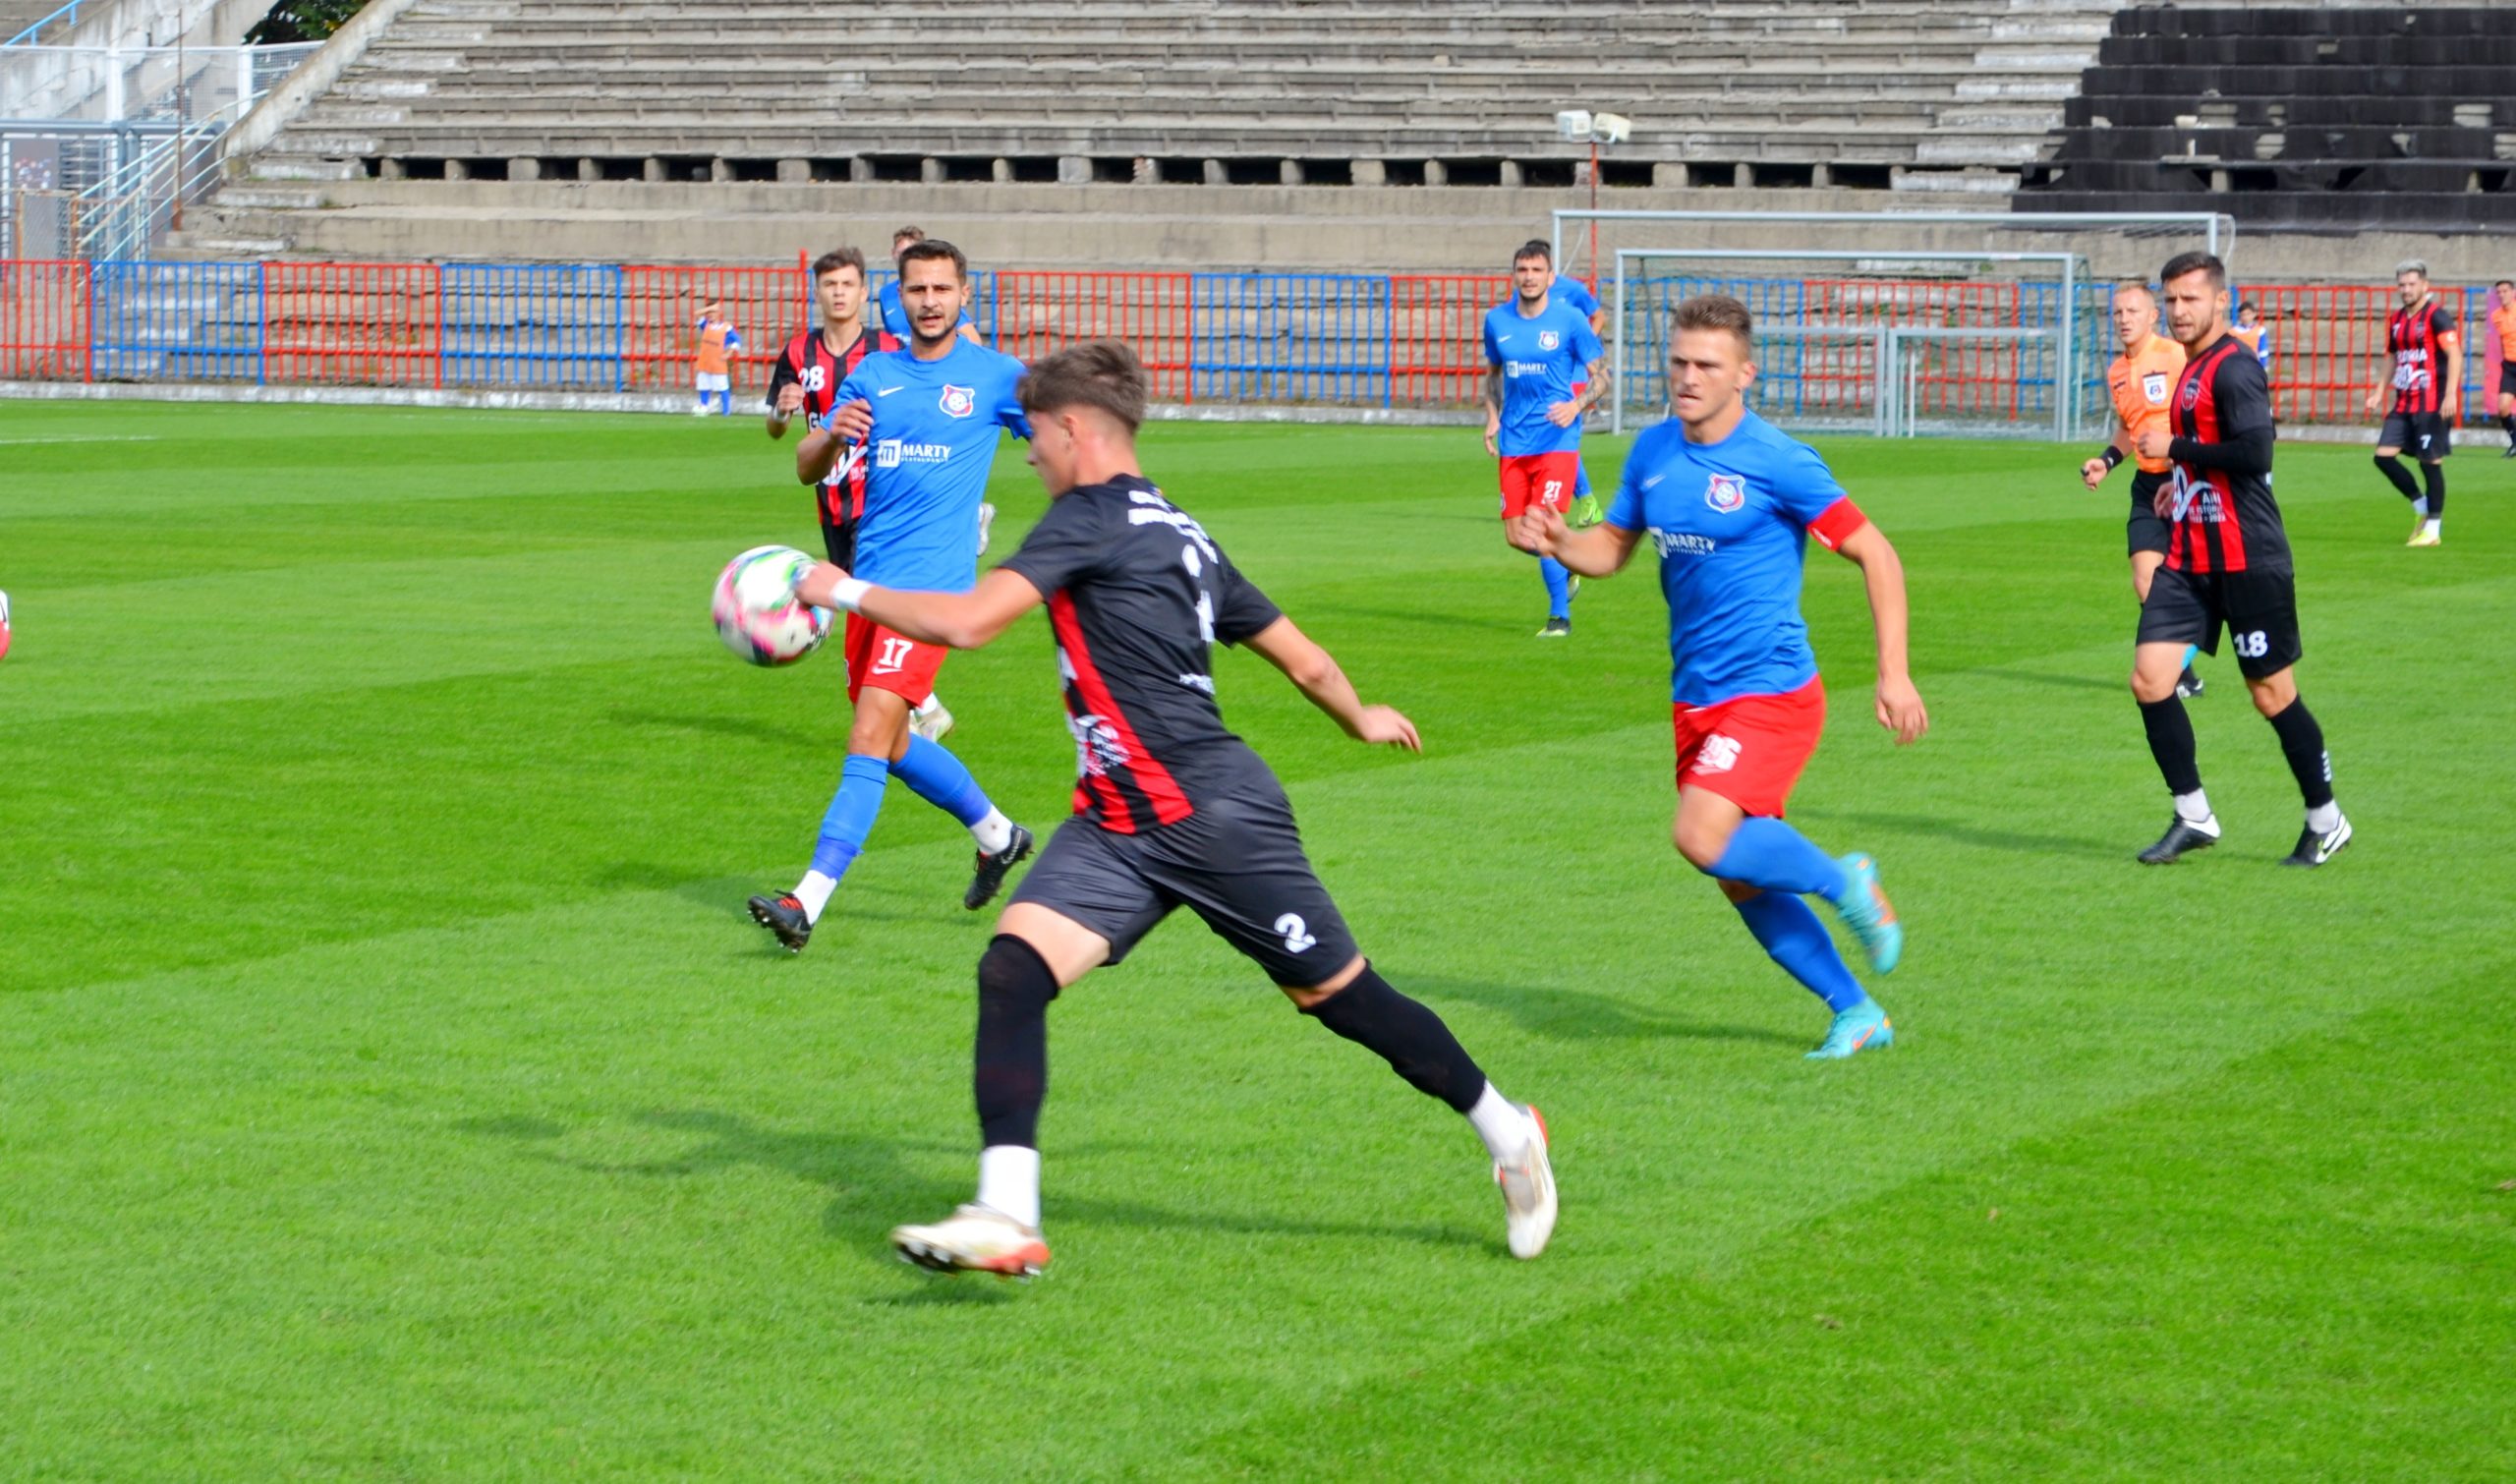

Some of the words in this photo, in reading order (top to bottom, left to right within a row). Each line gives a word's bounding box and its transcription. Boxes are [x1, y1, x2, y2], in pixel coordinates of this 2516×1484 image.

[797, 365, 826, 393] 28
[901, 444, 951, 461] MARTY
[2420, 433, 2432, 449] 7
[1663, 533, 1716, 551] MARTY
[878, 637, 914, 669] 17
[2233, 630, 2268, 657] 18
[1274, 912, 1317, 954] 2
